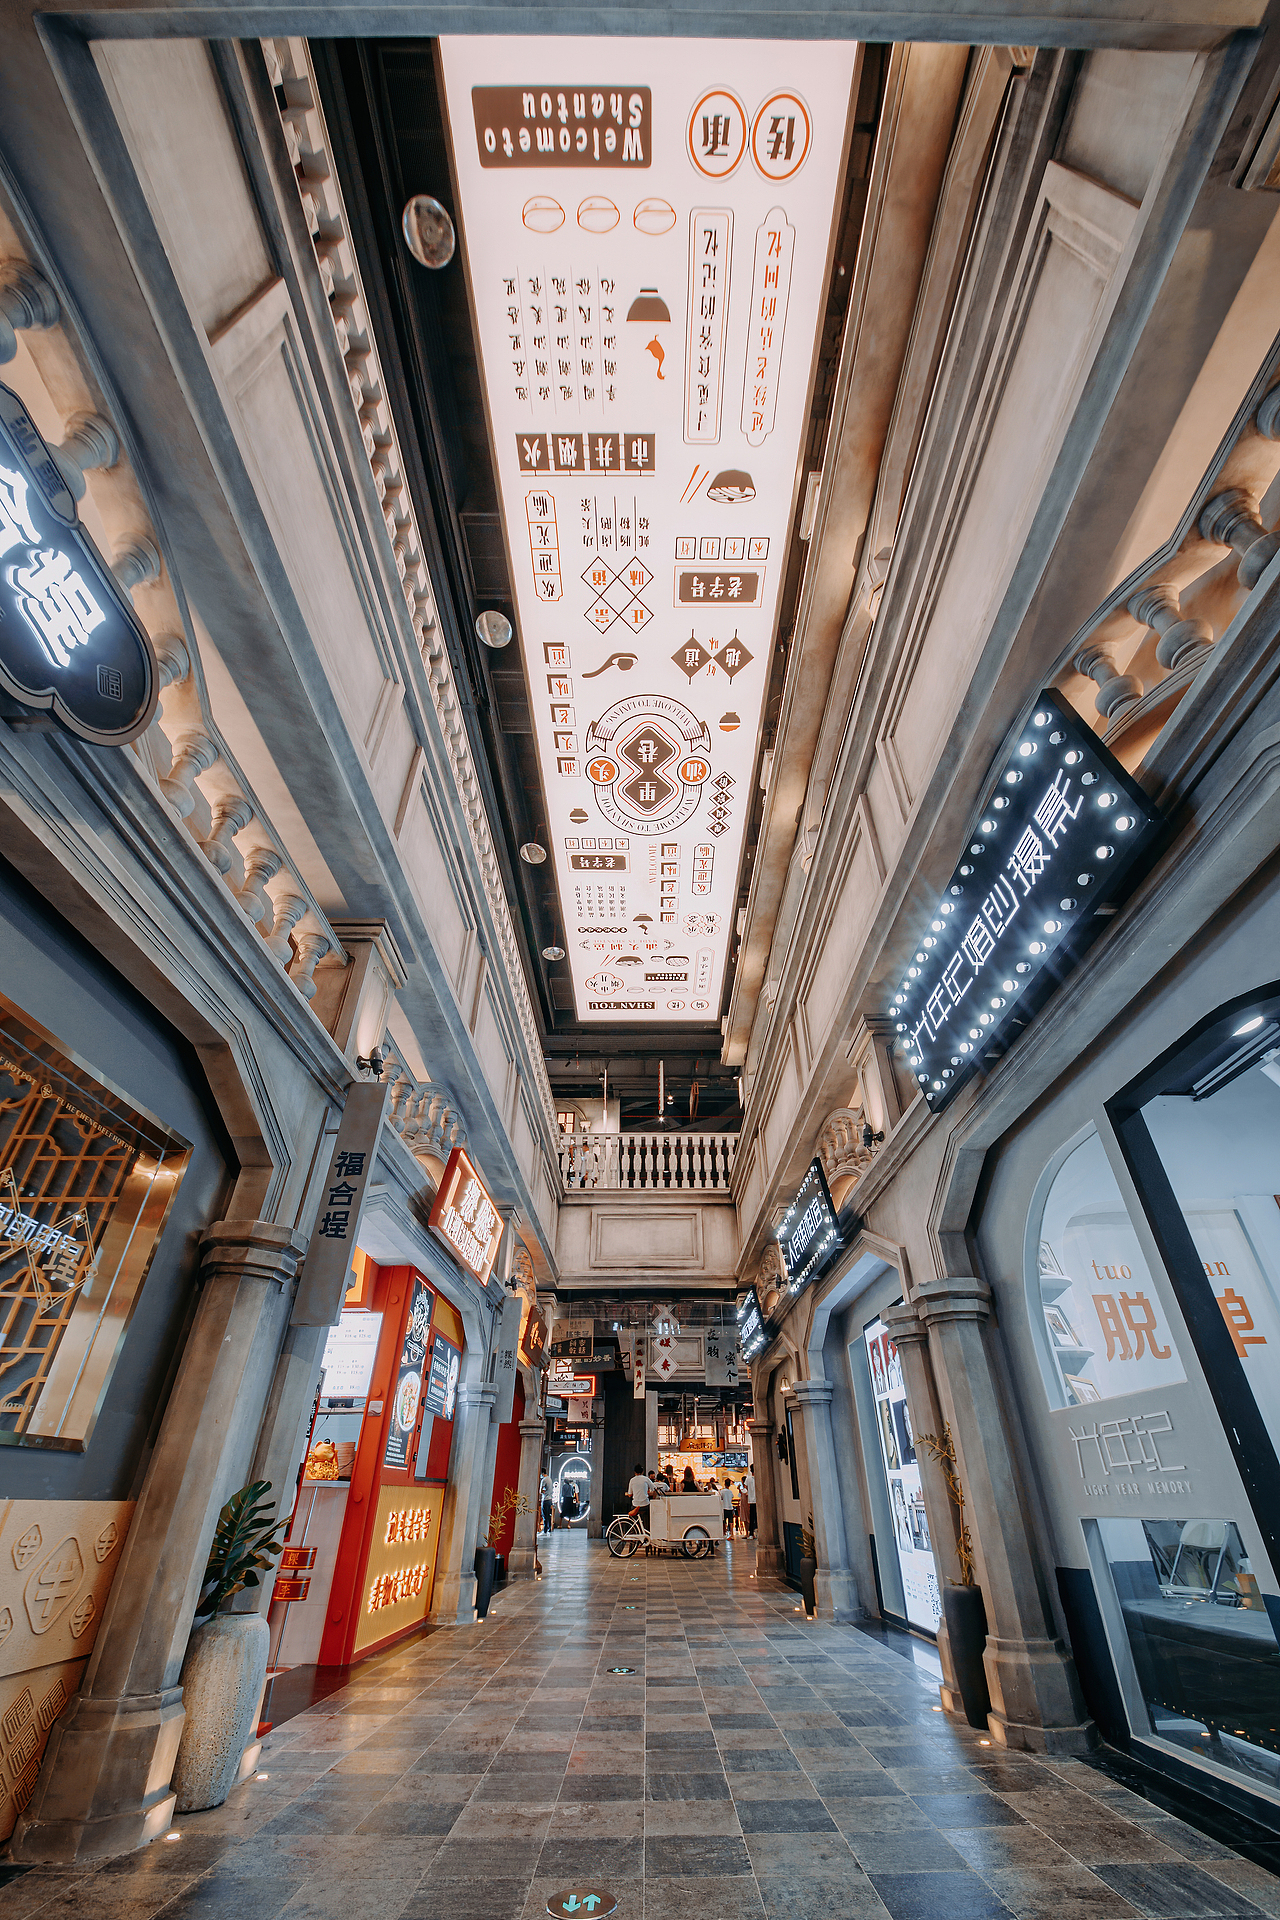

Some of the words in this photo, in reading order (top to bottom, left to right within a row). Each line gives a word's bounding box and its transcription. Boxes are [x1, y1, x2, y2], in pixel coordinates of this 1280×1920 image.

[522, 93, 644, 128] Shantou
[702, 114, 796, 161] 传承
[529, 277, 550, 401] 品潮汕美食
[698, 229, 719, 431] 寻觅食客的记忆
[752, 231, 783, 431] 延续老店的回忆
[522, 437, 649, 468] 市井烟火
[580, 498, 594, 548] 功夫茶
[600, 517, 612, 548] 卤鹅
[619, 517, 631, 548] 肠粉
[638, 517, 650, 548] 蚝烙
[532, 496, 555, 598] 欢迎光临
[681, 541, 764, 556] 永不打烊
[690, 576, 743, 598] 老字号
[684, 648, 742, 668] 地道
[551, 648, 577, 775] 汕头老味道
[638, 699, 651, 708] TO
[652, 699, 691, 727] WELCOME
[638, 740, 658, 802] 里巷
[601, 797, 636, 830] SHANTOU
[637, 824, 651, 832] TO
[653, 798, 694, 831] WELCOME
[579, 856, 616, 868] 老字号
[648, 843, 657, 884] WELCOME
[697, 846, 710, 892] 欢迎光临
[666, 847, 677, 923] 汕头老味道
[591, 1002, 617, 1010] TOU
[620, 1002, 653, 1010] SHAN
[3, 1061, 38, 1086] HOTPOT
[56, 1096, 66, 1107] FU
[65, 1102, 76, 1113] HE
[75, 1109, 98, 1129] CHENG
[112, 1135, 137, 1154] HOTPOT
[319, 1150, 367, 1239] 福合埕
[1091, 1259, 1133, 1281] tuo
[1203, 1261, 1232, 1278] an
[1083, 1484, 1109, 1496] LIGHT
[1115, 1482, 1140, 1495] YEAR
[1147, 1480, 1193, 1494] MEMORY
